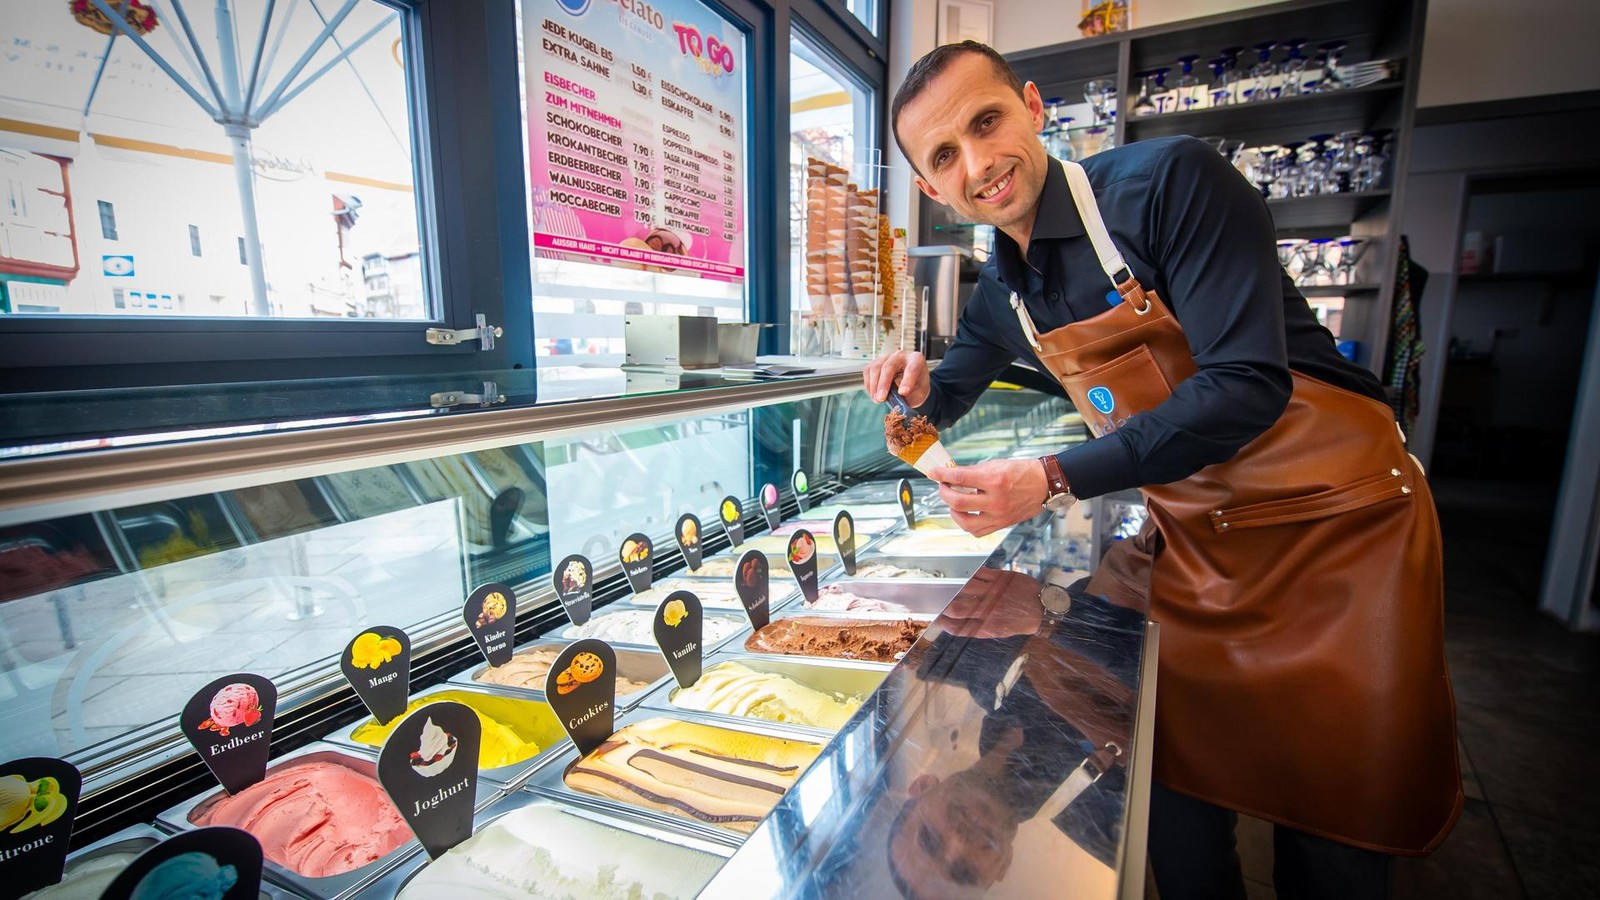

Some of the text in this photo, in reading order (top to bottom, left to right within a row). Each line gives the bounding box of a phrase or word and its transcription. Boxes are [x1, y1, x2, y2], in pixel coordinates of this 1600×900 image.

[604, 0, 664, 30] elato
[542, 19, 566, 38] JEDE
[568, 31, 599, 54] KUGEL
[600, 47, 613, 61] EIS
[673, 23, 703, 57] TO
[707, 36, 734, 73] GO
[542, 38, 578, 63] EXTRA
[580, 56, 610, 78] SAHNE
[544, 71, 596, 101] EISBECHER
[661, 80, 714, 113] EISSCHOKOLADE
[545, 92, 622, 129] ZUM MITNEHMEN
[661, 96, 694, 119] EISKAFFEE
[547, 112, 623, 147] SCHOKOBECHER
[633, 143, 649, 157] 7.90
[662, 124, 690, 141] ESPRESSO
[547, 131, 629, 166] KROKANTBECHER
[634, 160, 650, 173] 7.90
[663, 151, 681, 165] TASSE
[681, 159, 700, 171] KAFFEE
[694, 150, 719, 165] ESPRESSO
[548, 151, 622, 182] ERDBEERBECHER
[634, 177, 650, 190] 7.90
[663, 165, 680, 177] POTT
[680, 171, 699, 183] KAFFEE
[549, 171, 628, 201] WALNUSSBECHER
[634, 194, 650, 207] 7.90
[664, 192, 700, 208] CAPPUCCINO
[683, 183, 717, 201] SCHOKOLADE
[550, 190, 620, 216] MOCCABECHER
[635, 210, 650, 223] 7.90
[664, 205, 699, 220] MILCHKAFFEE
[664, 218, 681, 229] LATTE
[552, 238, 578, 249] AUSSER
[578, 241, 596, 252] HAUS
[602, 244, 620, 255] NICHT
[620, 248, 644, 259] ERLAUBT
[484, 630, 506, 643] Kinder
[486, 642, 507, 654] Bueno
[672, 641, 697, 660] Vanille
[368, 671, 398, 688] Mango
[568, 701, 609, 730] Cookies
[210, 729, 265, 756] Erdbeer
[413, 776, 469, 816] Joghurt
[0, 834, 54, 862] itrone
